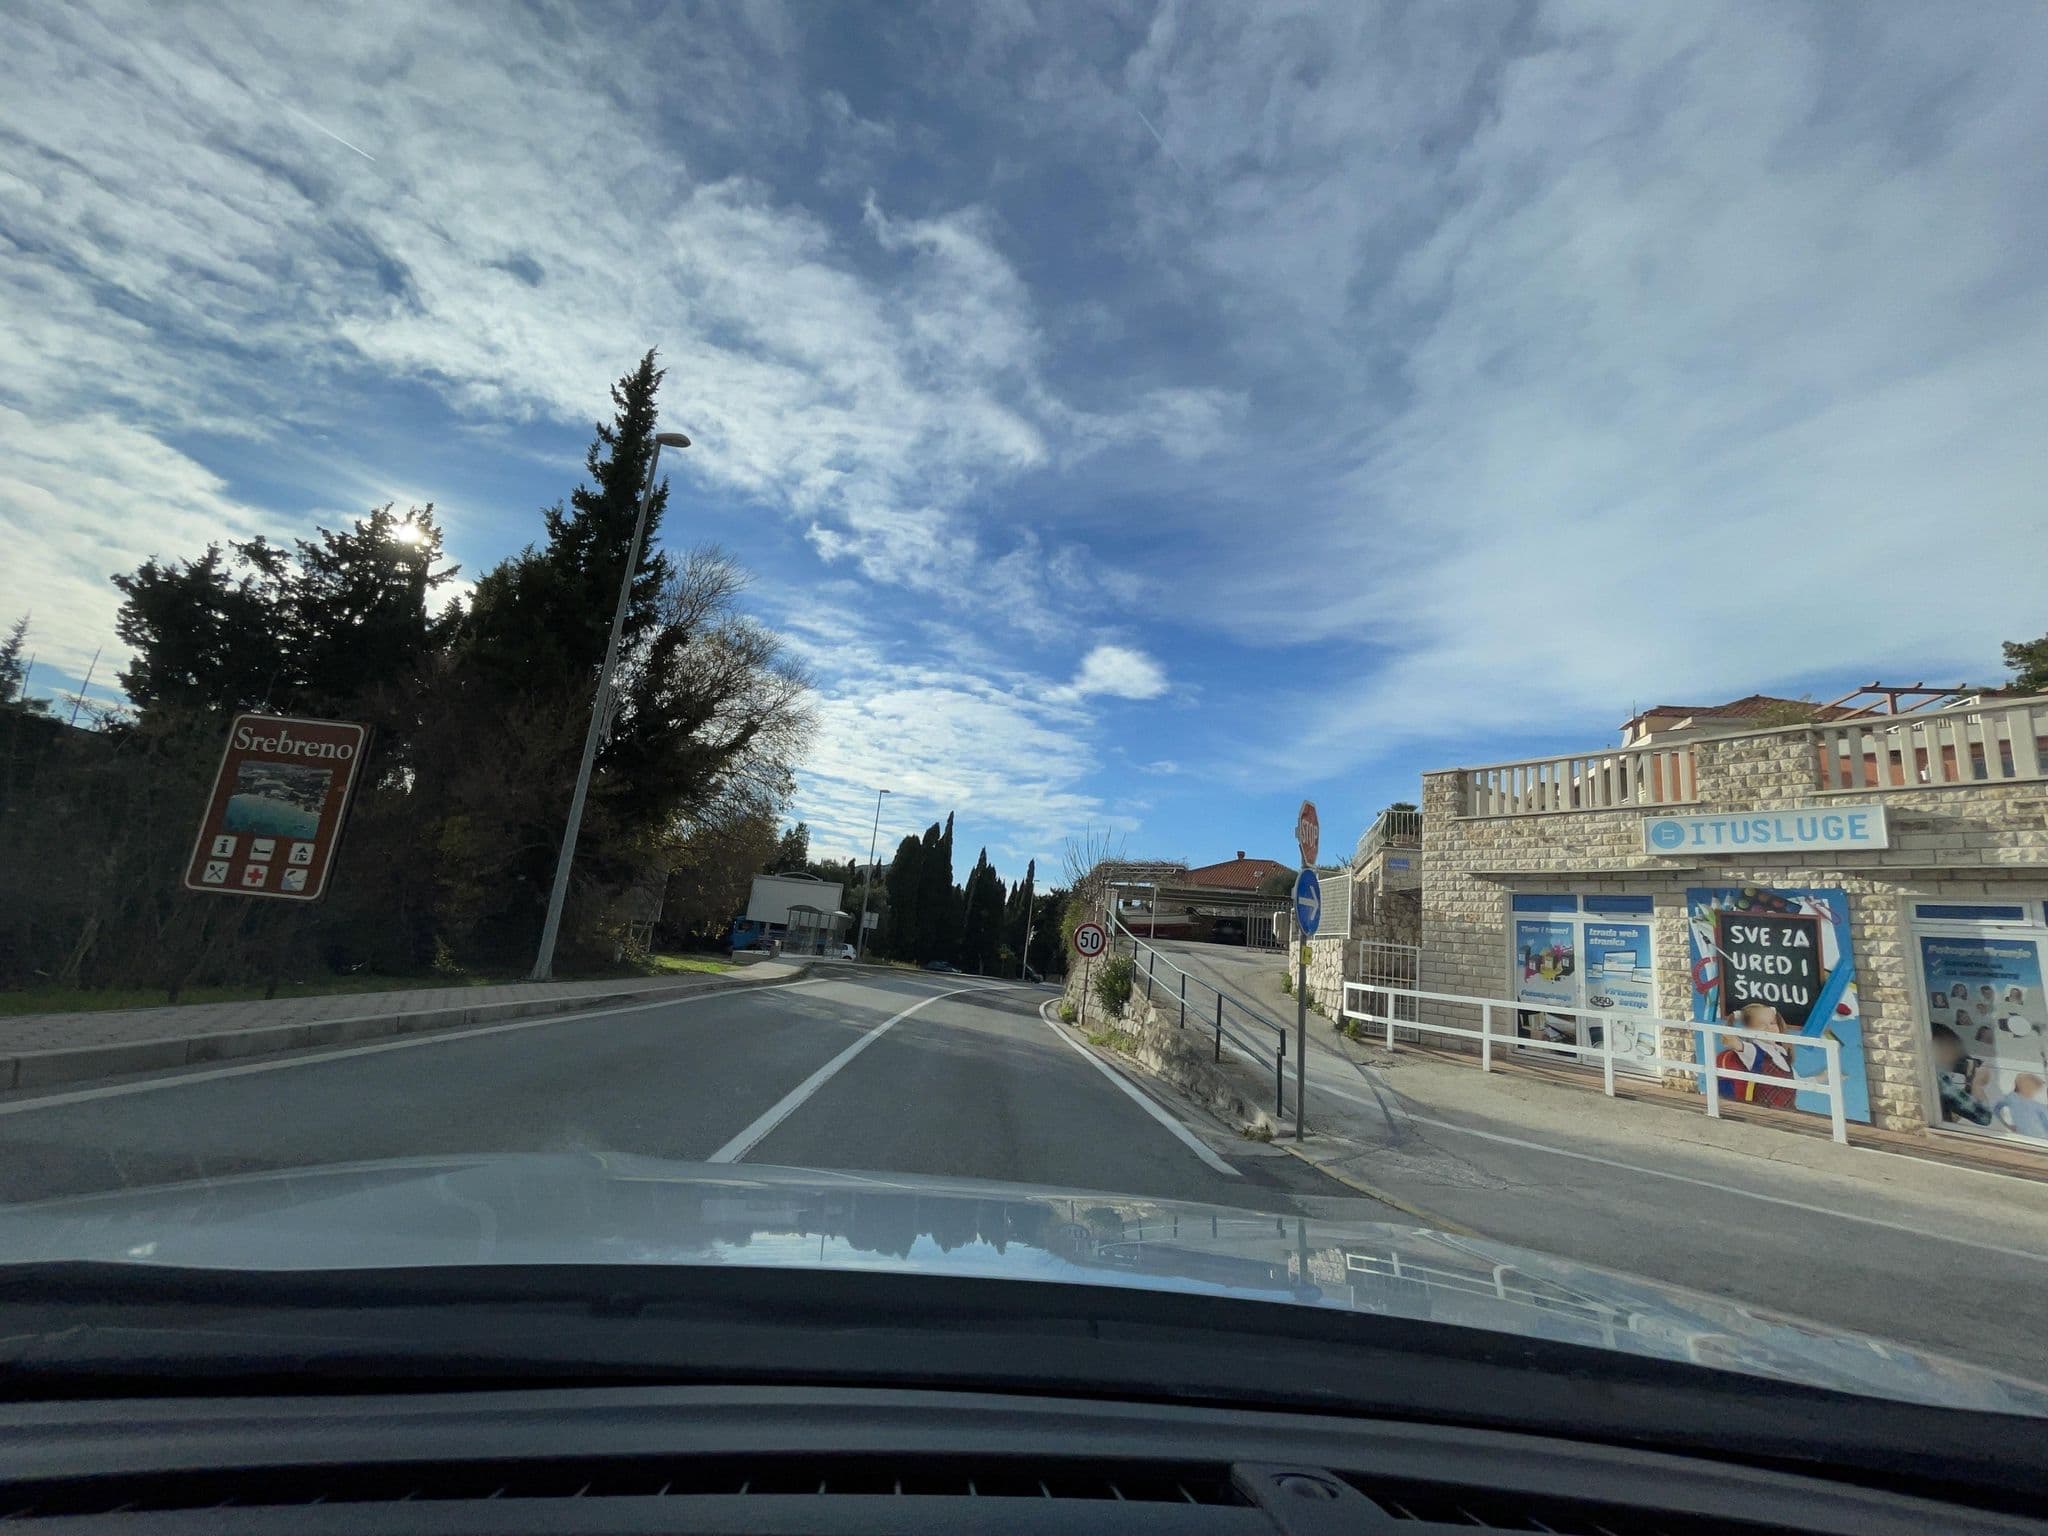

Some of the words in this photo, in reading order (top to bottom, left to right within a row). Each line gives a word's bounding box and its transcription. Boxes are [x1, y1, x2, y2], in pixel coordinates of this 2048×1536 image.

[234, 727, 353, 760] Srebreno
[1301, 821, 1318, 849] STOP
[1080, 931, 1100, 949] 50
[1589, 928, 1617, 937] Izrada
[1618, 929, 1639, 938] web
[1589, 937, 1626, 947] stranica
[1730, 925, 1770, 947] SVE
[1782, 929, 1810, 948] ZA
[1733, 952, 1793, 977] URED
[1801, 958, 1809, 977] I
[1734, 974, 1809, 1006] ŠKOLU
